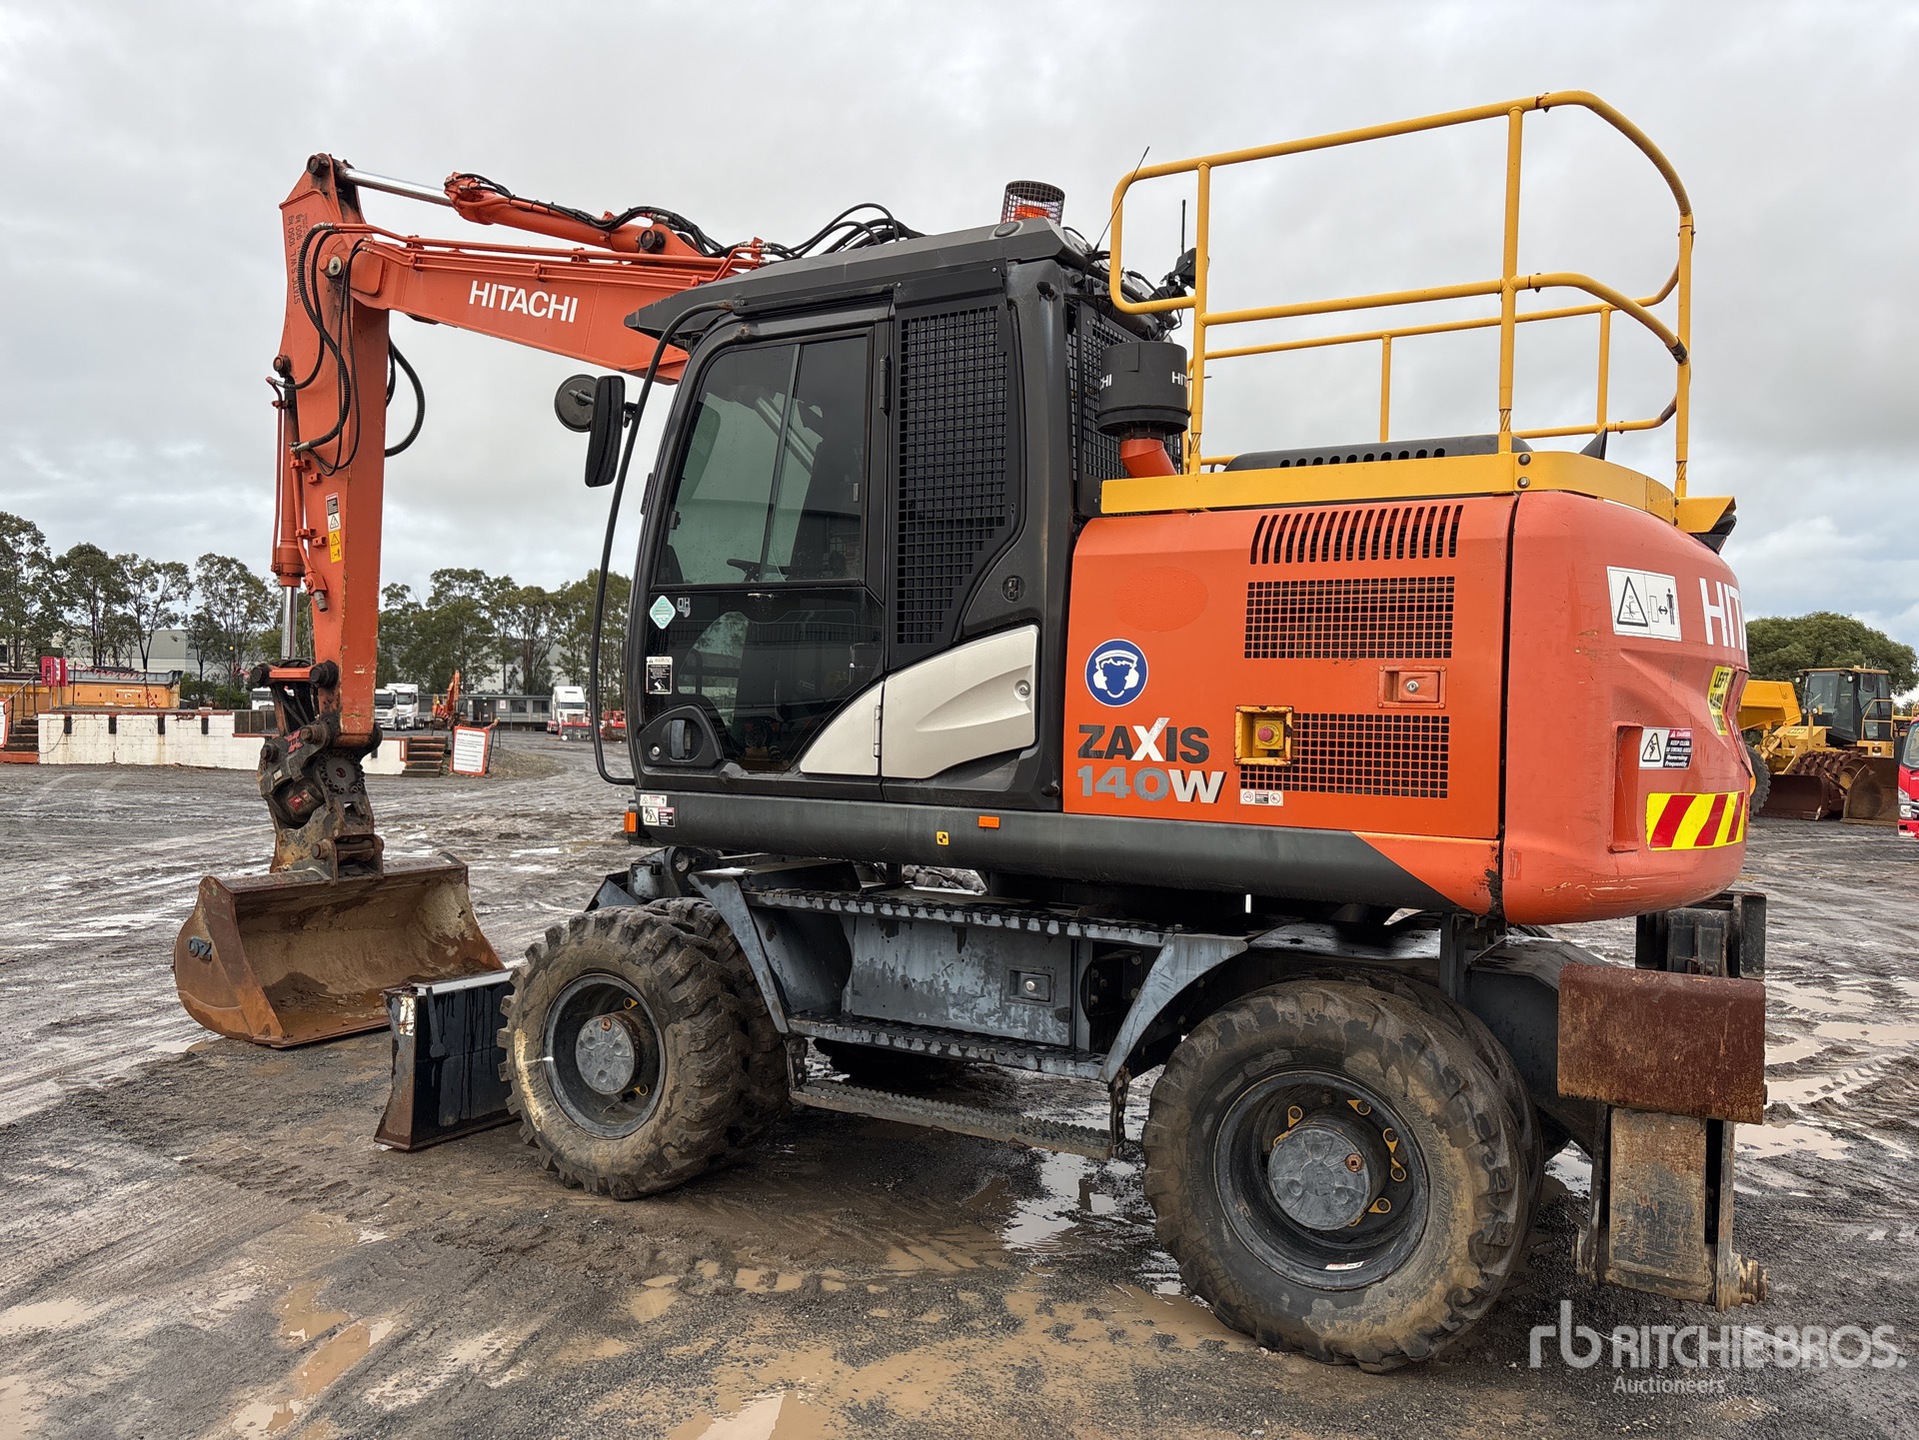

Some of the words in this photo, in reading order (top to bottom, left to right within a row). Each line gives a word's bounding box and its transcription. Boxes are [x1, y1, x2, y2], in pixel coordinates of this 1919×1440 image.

[288, 215, 295, 226] kg
[296, 213, 304, 223] kg
[288, 228, 296, 247] 1050
[292, 277, 300, 304] STATIC
[469, 280, 578, 323] HITACHI
[1699, 577, 1747, 652] HIT
[1713, 671, 1729, 688] LEFT
[1078, 717, 1210, 764] ZAXIS
[1077, 765, 1227, 804] 140W
